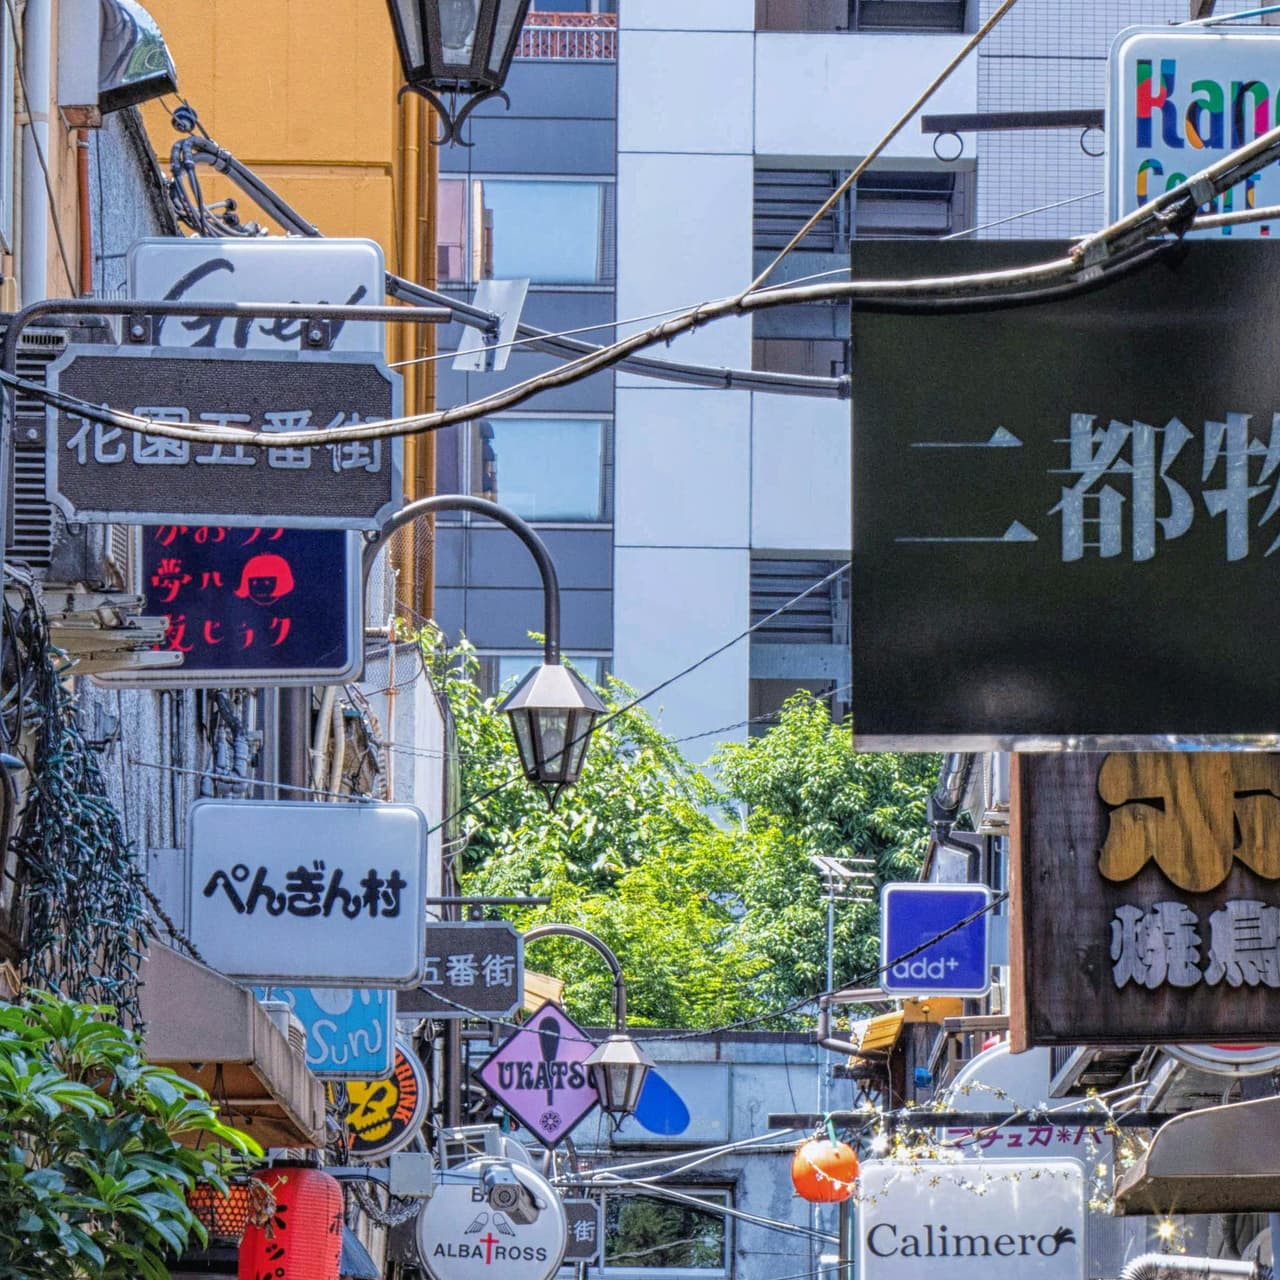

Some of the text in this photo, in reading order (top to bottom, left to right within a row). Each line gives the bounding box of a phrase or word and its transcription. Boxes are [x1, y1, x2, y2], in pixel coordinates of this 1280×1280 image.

[65, 402, 385, 474] 花園五番街
[202, 859, 408, 919] ぺんぎん村
[433, 1232, 548, 1265] ALBATROSS
[866, 1221, 1066, 1260] Calimero
